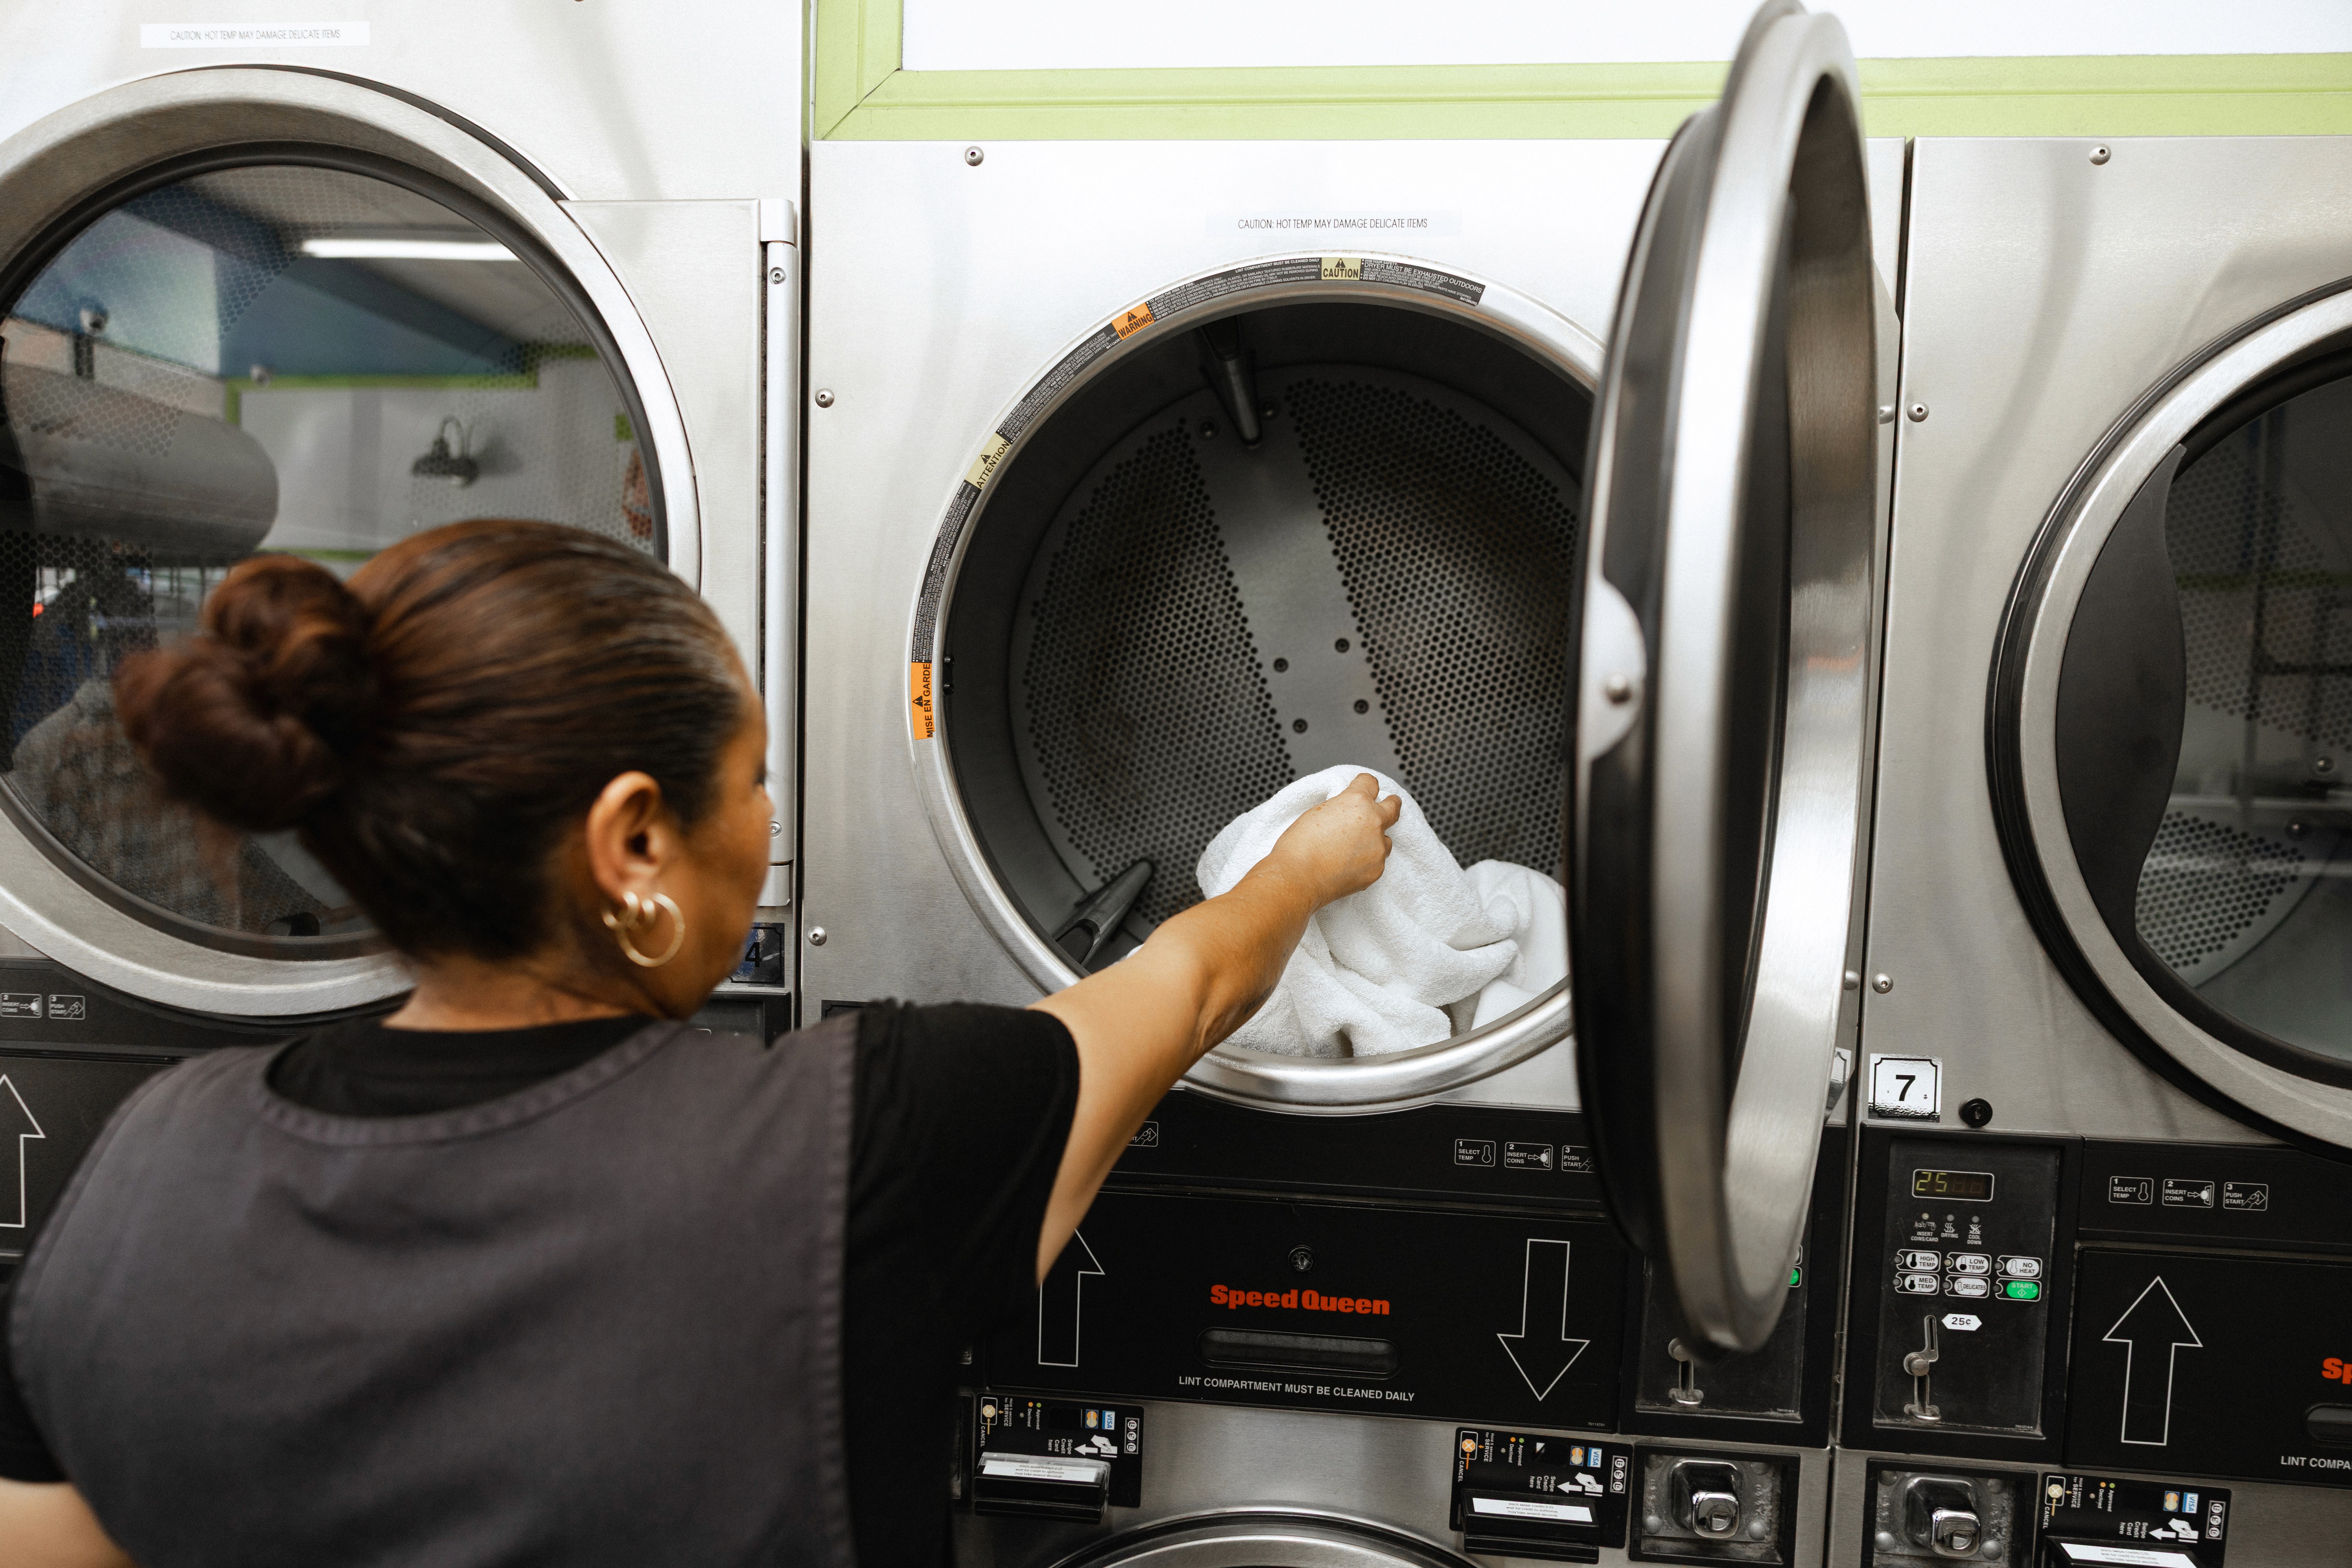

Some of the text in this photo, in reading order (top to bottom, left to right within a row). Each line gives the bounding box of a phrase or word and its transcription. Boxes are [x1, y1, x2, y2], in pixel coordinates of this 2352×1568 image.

[171, 29, 340, 40] CAUTION: HOT TEMP MAY DAMAGE DELICATE ITEMS
[1238, 218, 1427, 229] CAUTION: HOT TEMP MAY DAMAGE DELICATE ITEMS
[1244, 262, 1273, 271] COMPARTMENT
[1323, 268, 1359, 278] CAUTION
[1385, 264, 1403, 272] MUST
[1413, 268, 1449, 282] EXHAUSTED
[1448, 277, 1483, 294] OUTDOORS
[1118, 312, 1153, 338] WARNING
[975, 439, 1010, 489] ATTENTION
[924, 699, 931, 712] EN
[925, 715, 933, 737] MISE
[745, 942, 763, 968] 4
[1896, 1074, 1916, 1101] 7
[1916, 1172, 1947, 1192] 25
[1210, 1284, 1390, 1315] Speed Queen
[1951, 1317, 1971, 1326] 25¢
[1179, 1376, 1415, 1402] LINT COMPARTMENT MUST BE CLEANED DAILY
[2280, 1455, 2352, 1470] LINT COMPA
